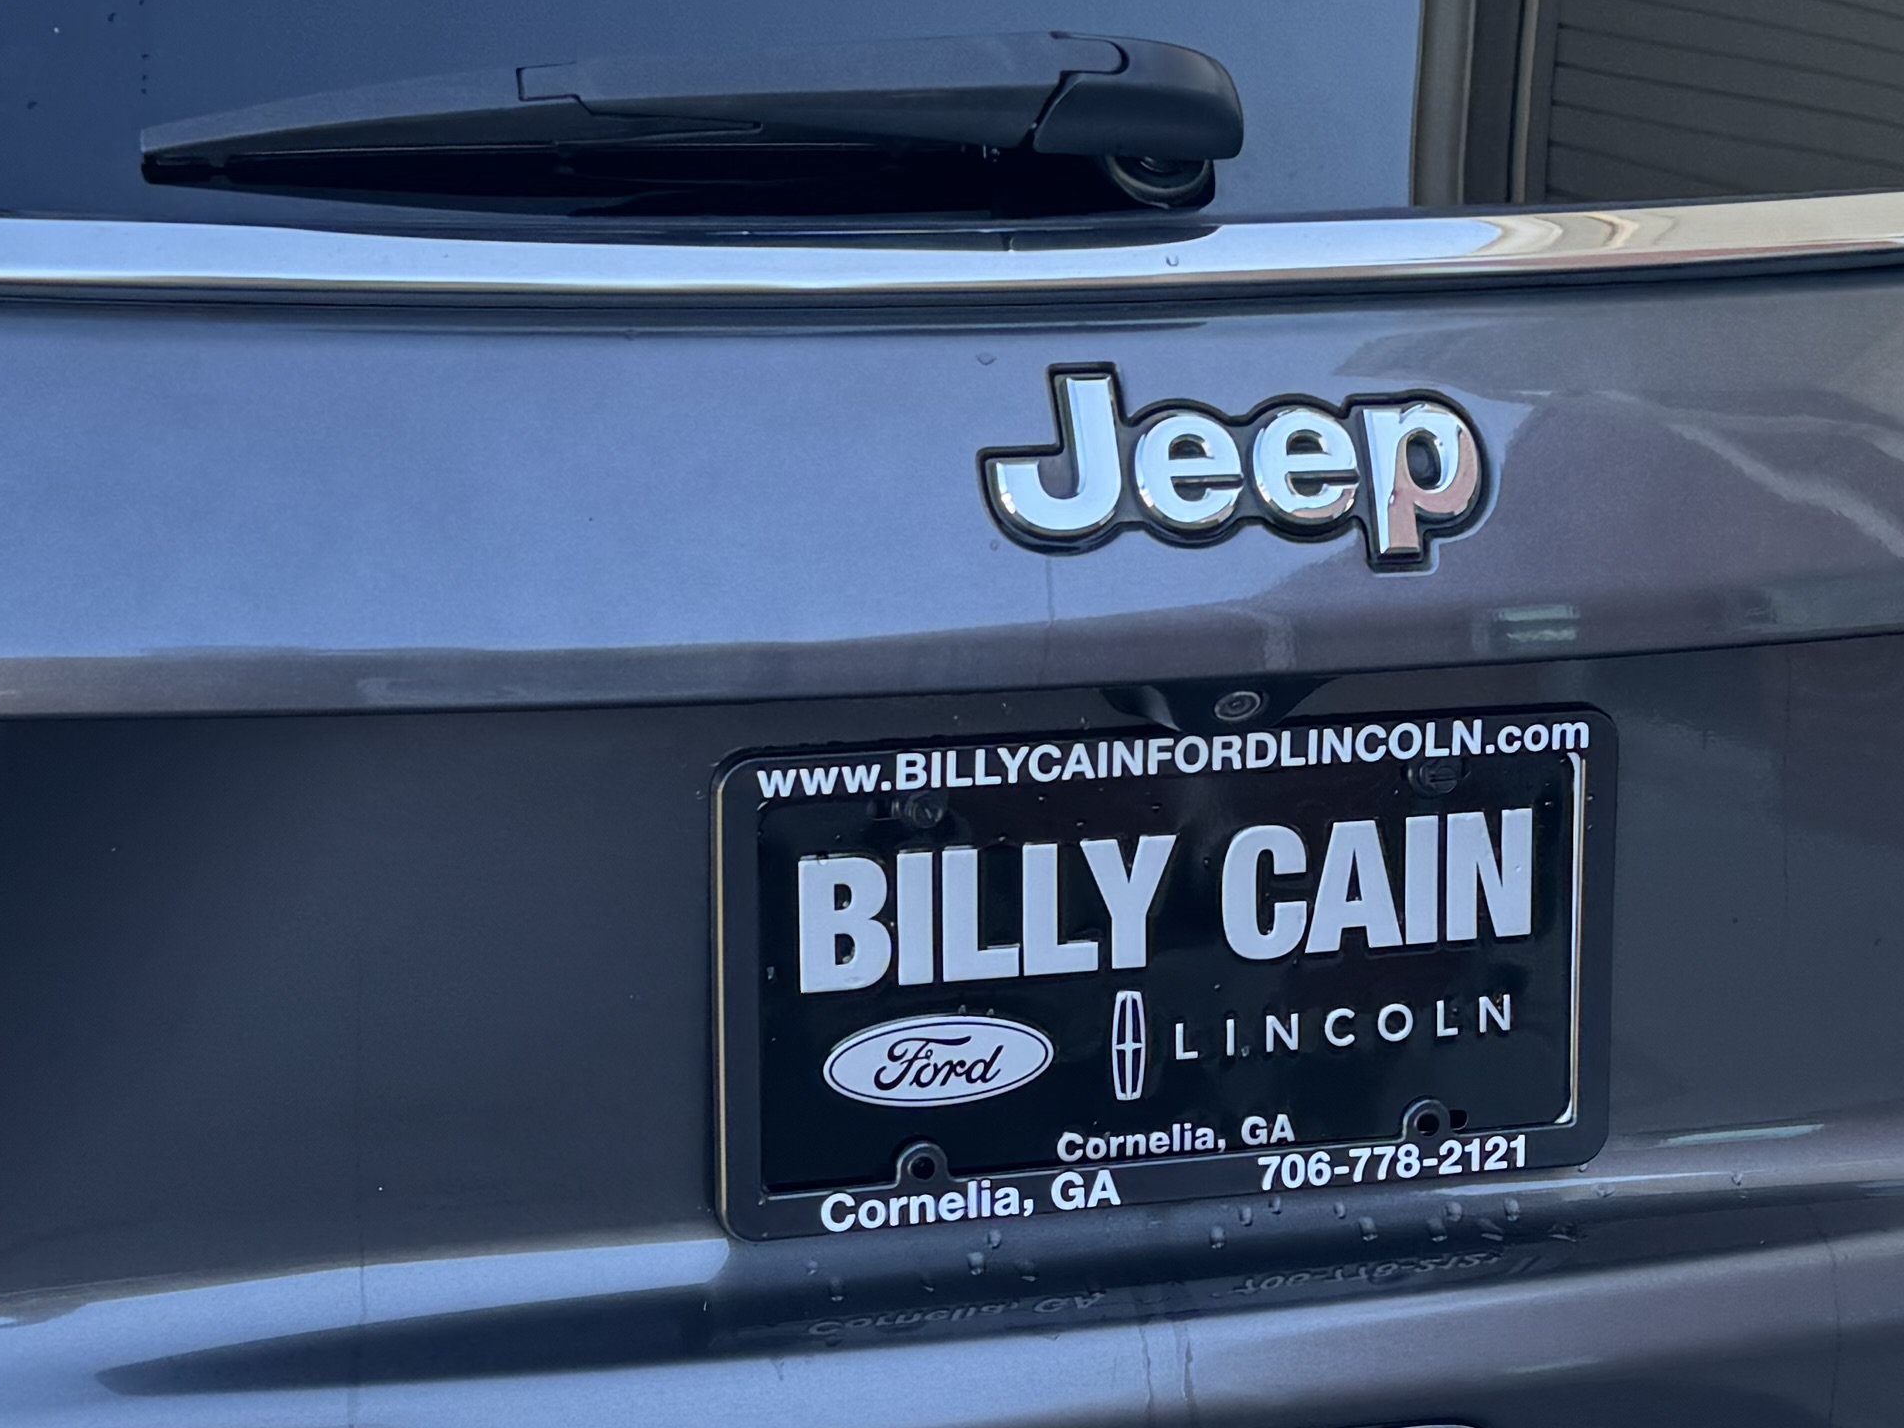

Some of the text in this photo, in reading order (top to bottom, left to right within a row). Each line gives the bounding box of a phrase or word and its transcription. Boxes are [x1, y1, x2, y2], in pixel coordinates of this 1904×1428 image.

[986, 368, 1492, 562] Jeep
[756, 718, 1589, 799] www.BILLYCAINFORDLINCOLN.com
[797, 807, 1534, 994] BILLY CAIN
[873, 992, 1514, 1091] Ford LINCOLN
[820, 1134, 1528, 1233] Cornelia, GA 706-778-2121
[1056, 1113, 1295, 1164] Cornelia, GA
